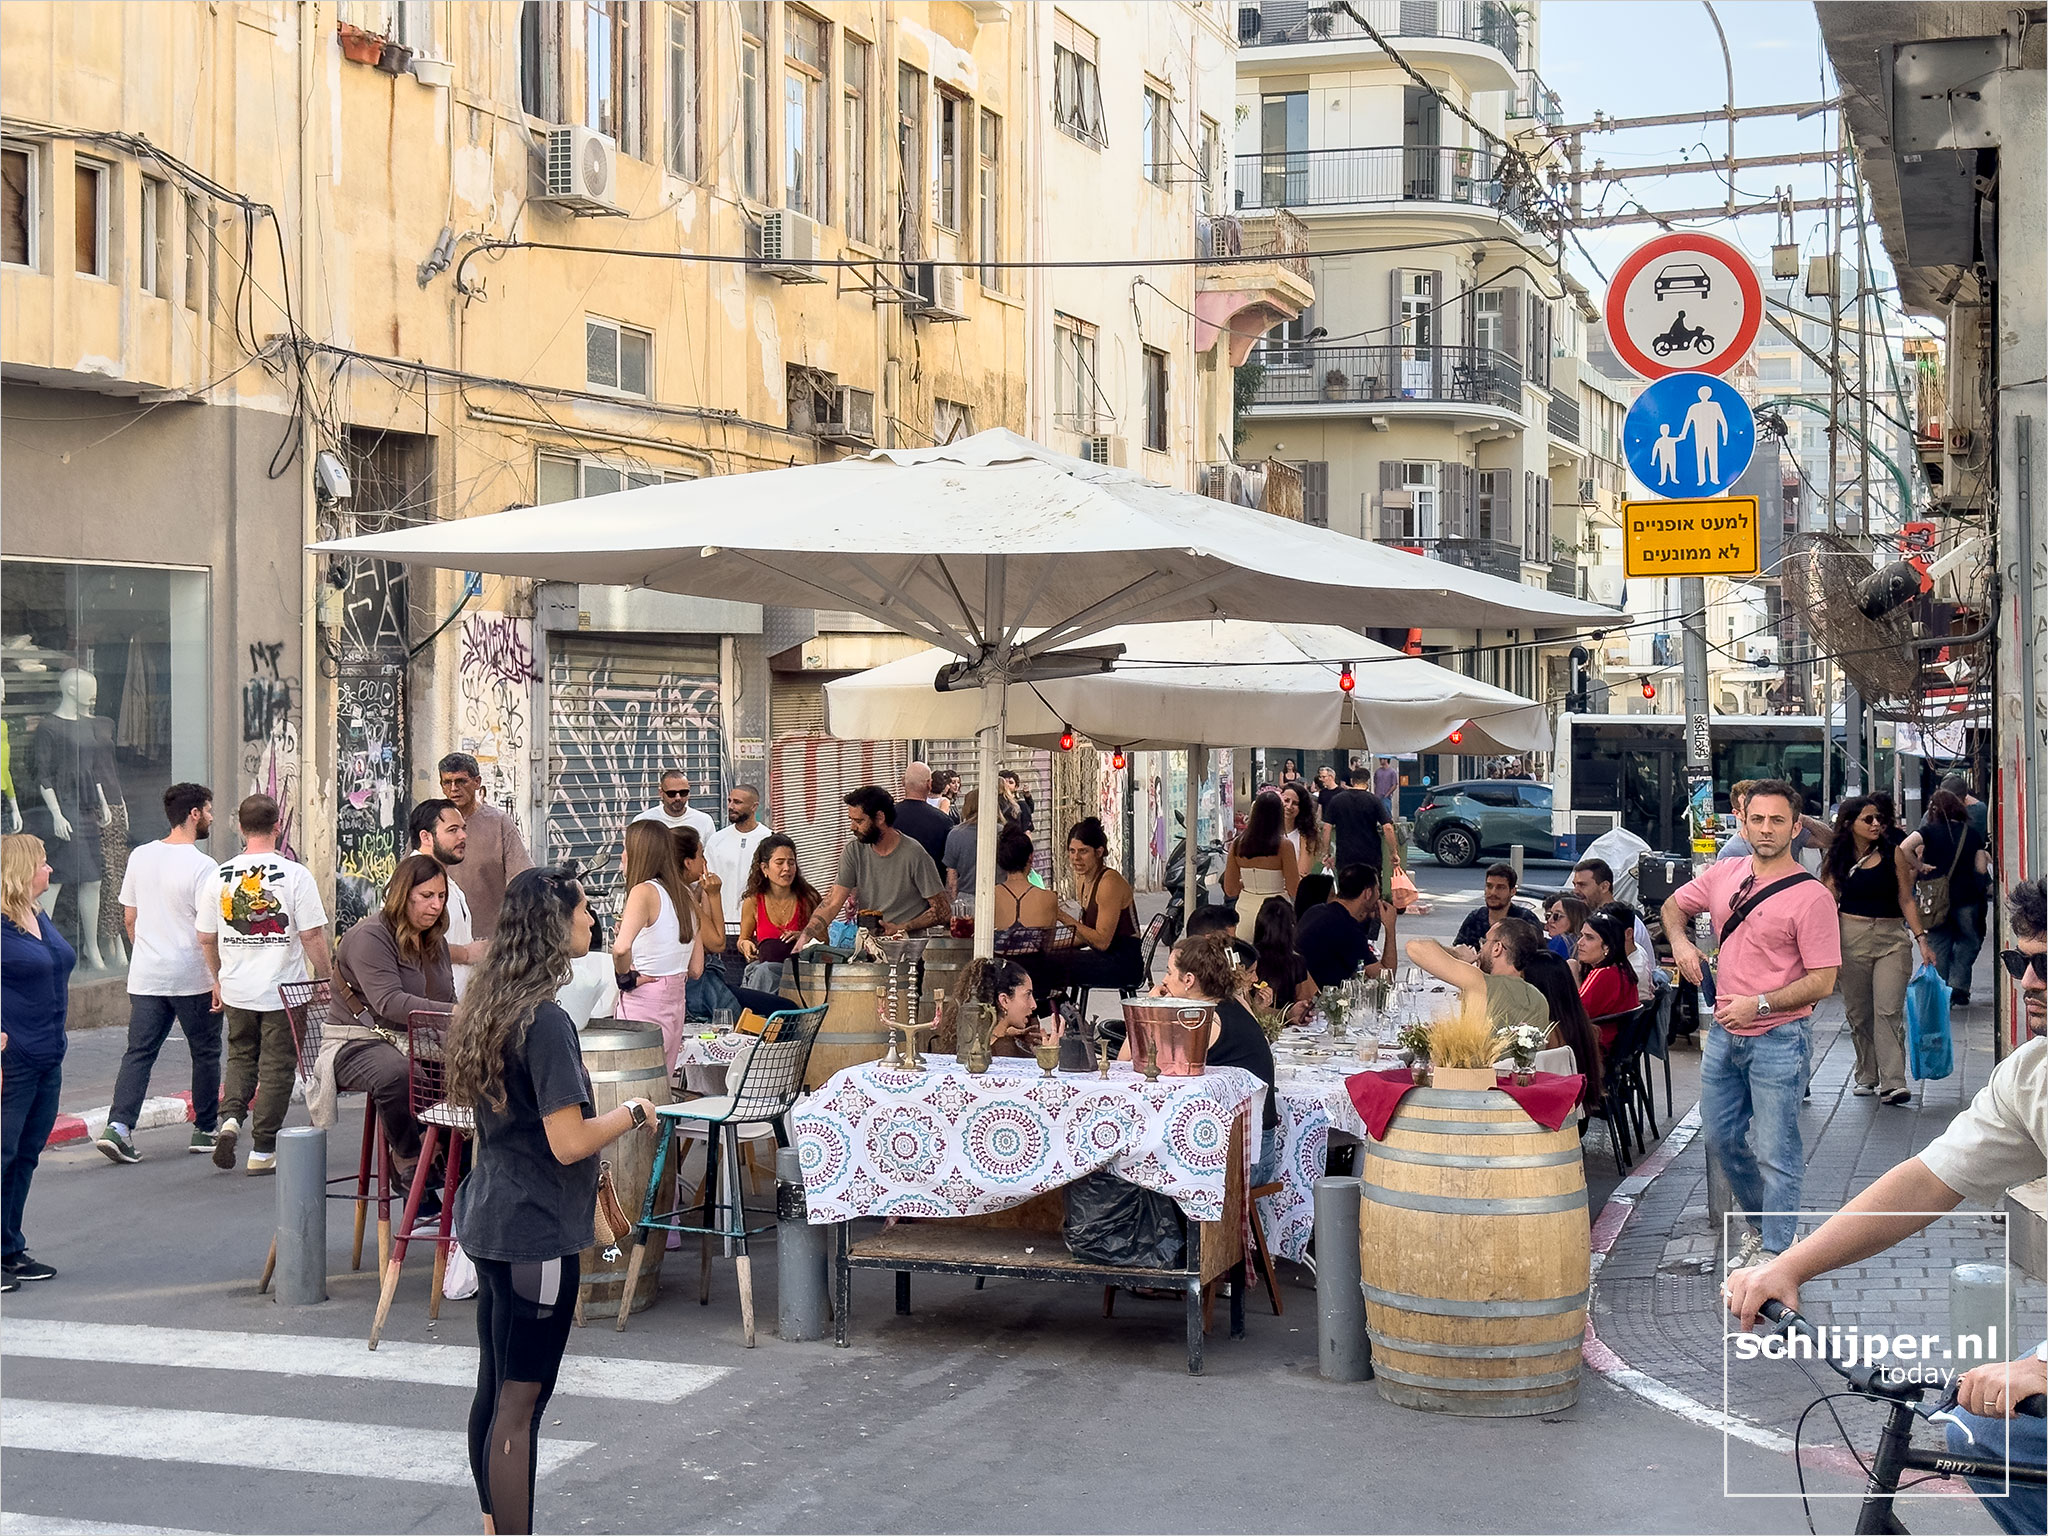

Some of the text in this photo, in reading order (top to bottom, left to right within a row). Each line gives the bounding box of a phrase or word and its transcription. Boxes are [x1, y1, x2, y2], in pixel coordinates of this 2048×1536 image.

[1633, 513, 1748, 532] למעט אופניים
[1643, 543, 1740, 562] לא ממונעים
[219, 864, 285, 883] ラーメン
